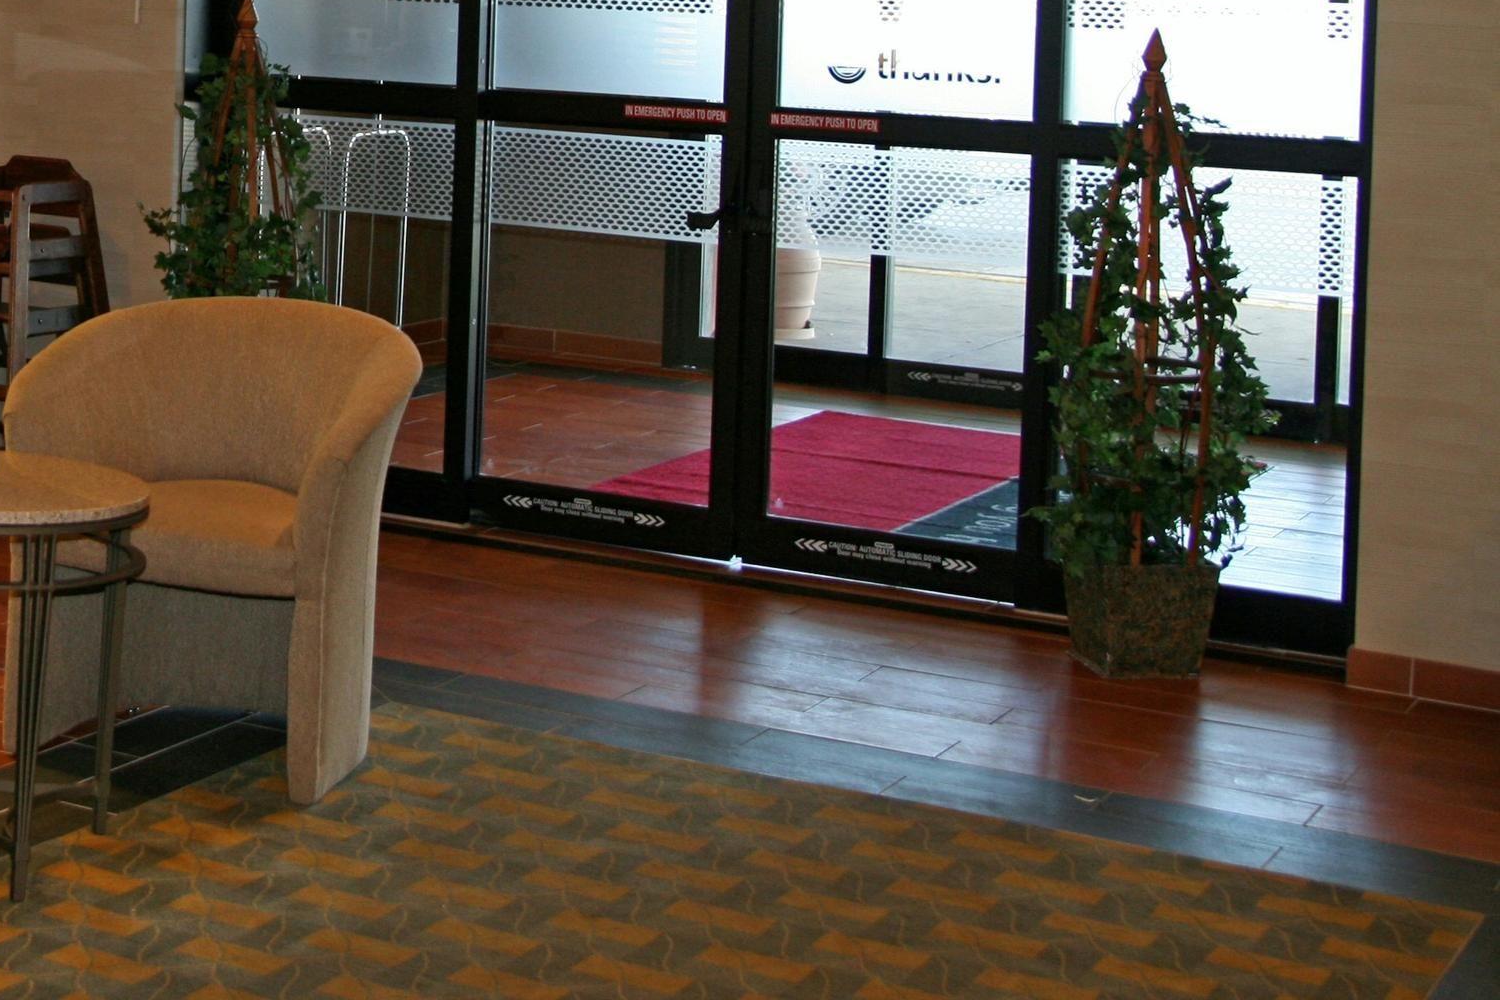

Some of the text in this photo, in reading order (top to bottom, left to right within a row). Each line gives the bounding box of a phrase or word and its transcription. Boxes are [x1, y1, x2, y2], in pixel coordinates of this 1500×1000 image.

[625, 104, 726, 121] IN EMERGENCY PUSH TO OPEN
[771, 113, 878, 130] IN EMERGENCY PUSH TO OPEN
[859, 545, 896, 557] AUTOMATIC
[897, 550, 922, 560] SLIDING
[923, 553, 941, 562] DOOR
